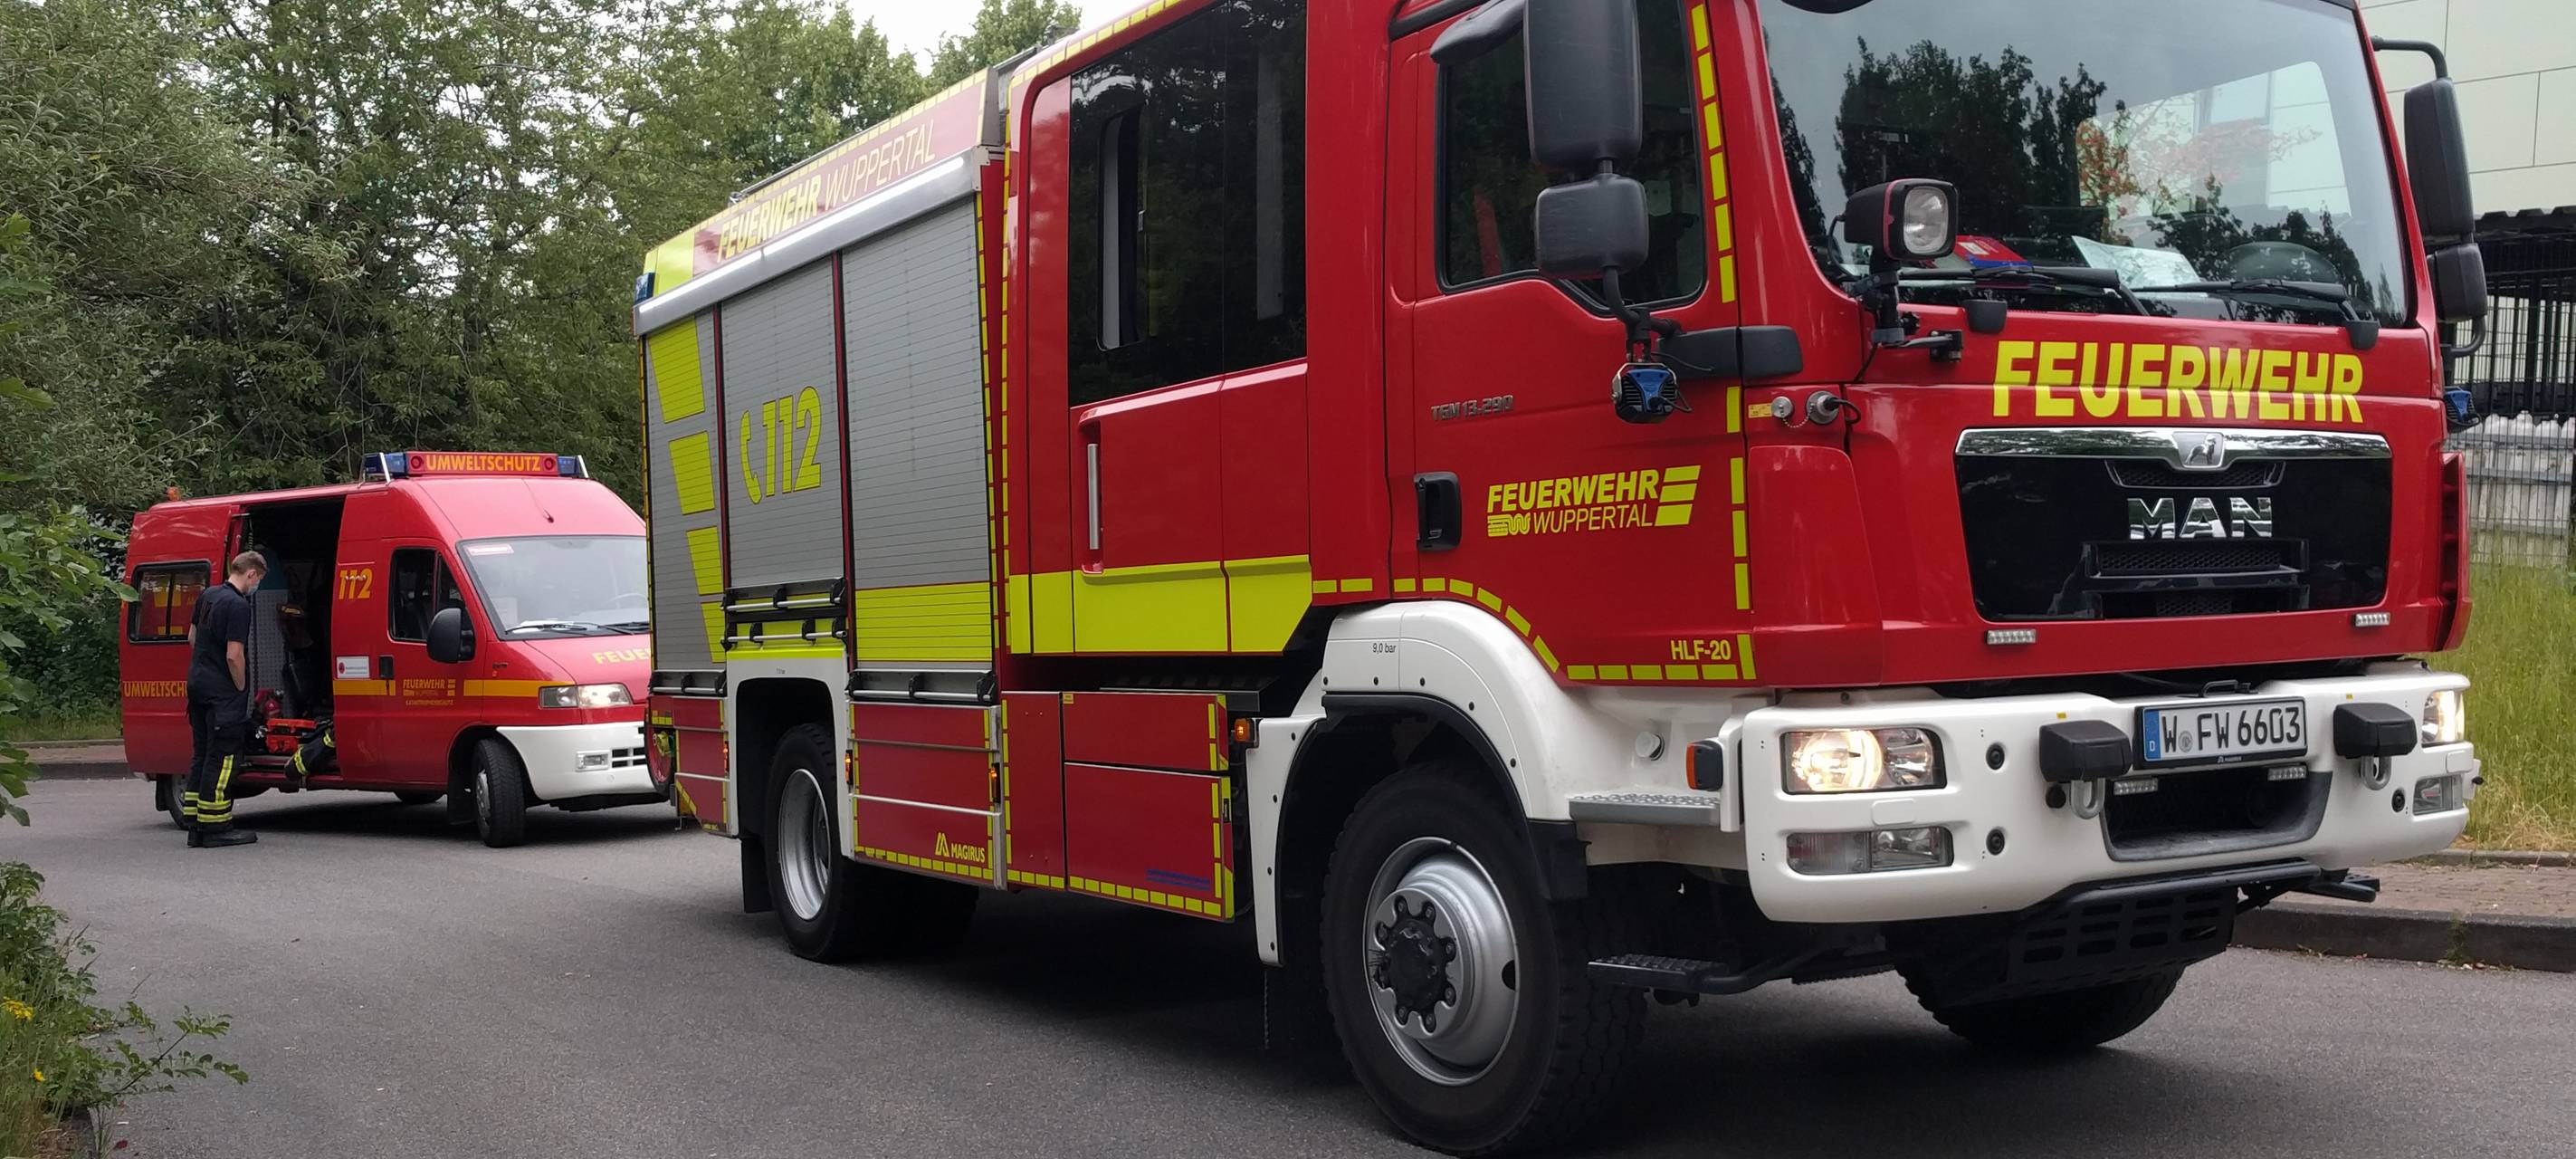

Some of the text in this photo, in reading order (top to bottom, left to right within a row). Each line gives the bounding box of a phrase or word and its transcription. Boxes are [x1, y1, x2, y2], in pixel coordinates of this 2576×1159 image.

[717, 119, 935, 263] FEUERWEHR WUPPERTAL
[1993, 340, 2363, 423] FEUERWEHR
[762, 386, 821, 497] 112
[425, 455, 541, 472] UMWELTSCHUTZ
[1487, 469, 1659, 513] FEUERWEHR
[1533, 503, 1653, 534] WUPPERTAL
[2127, 496, 2273, 540] MAN
[339, 568, 373, 600] 112
[592, 647, 651, 664] FEUE
[1385, 642, 1397, 653] bar
[1670, 639, 1732, 660] HLF-20
[403, 679, 445, 689] FEUERWEHR
[2161, 706, 2301, 752] W FW 6603
[2149, 741, 2156, 752] D
[951, 843, 986, 863] MAGIRUS
